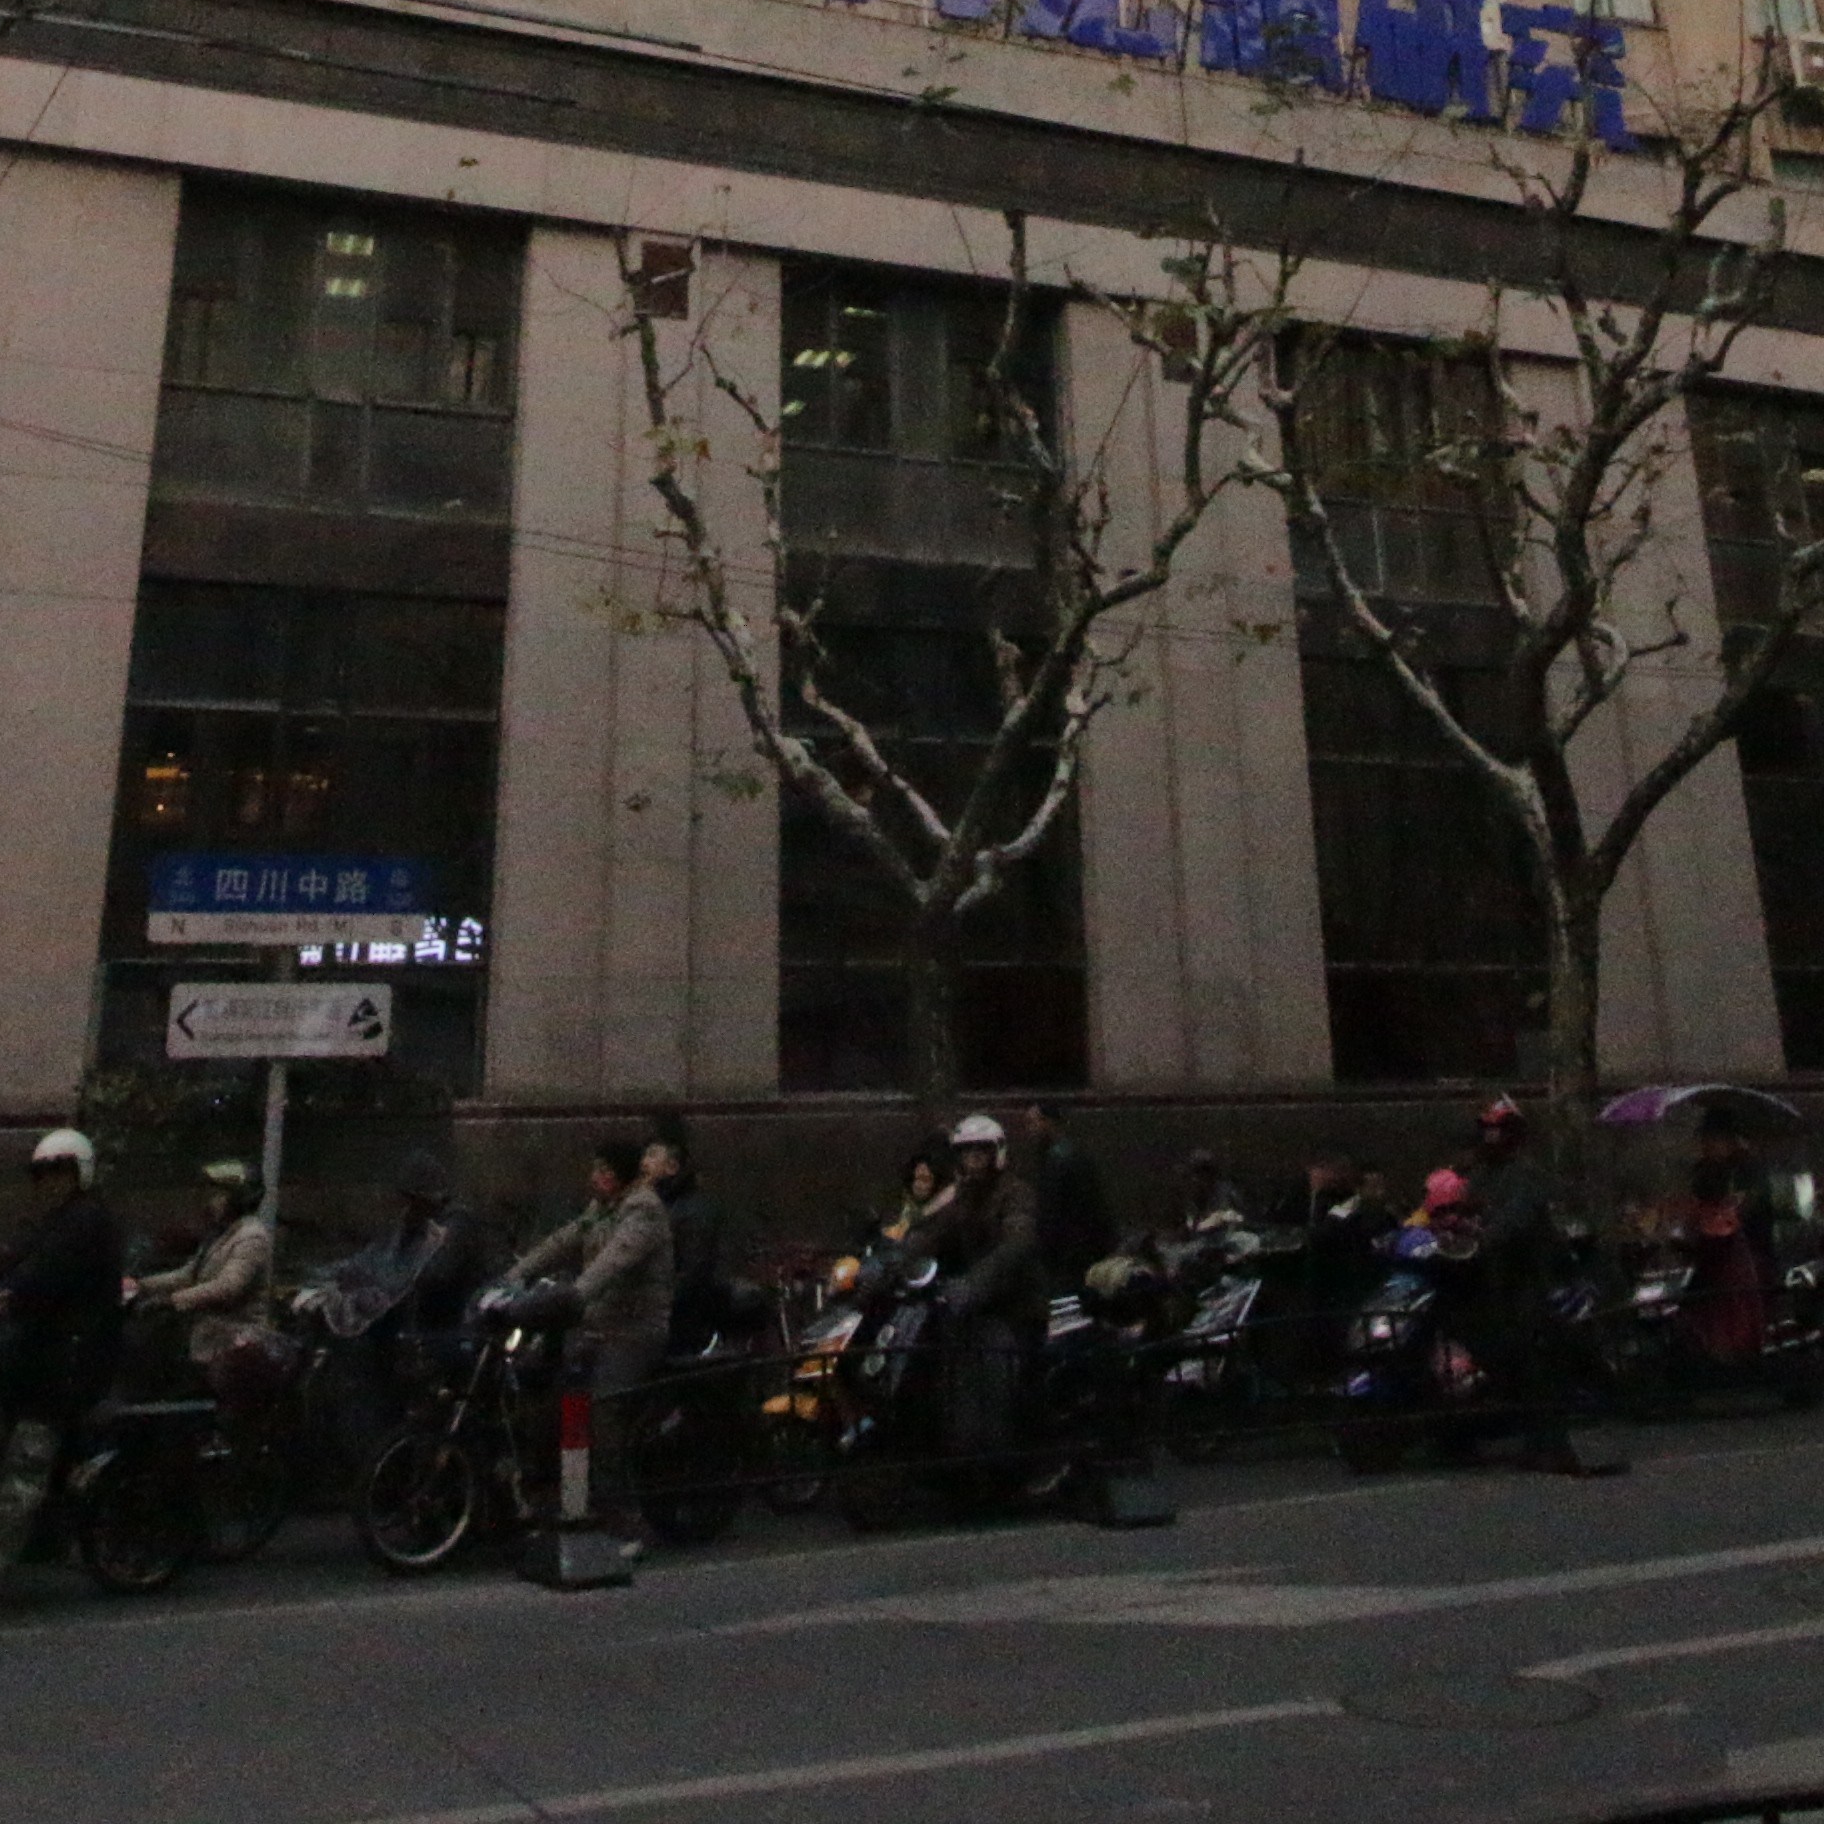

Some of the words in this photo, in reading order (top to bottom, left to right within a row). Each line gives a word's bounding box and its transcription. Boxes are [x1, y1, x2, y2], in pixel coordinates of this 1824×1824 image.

[214, 867, 368, 904] 四川中路
[171, 919, 186, 935] N
